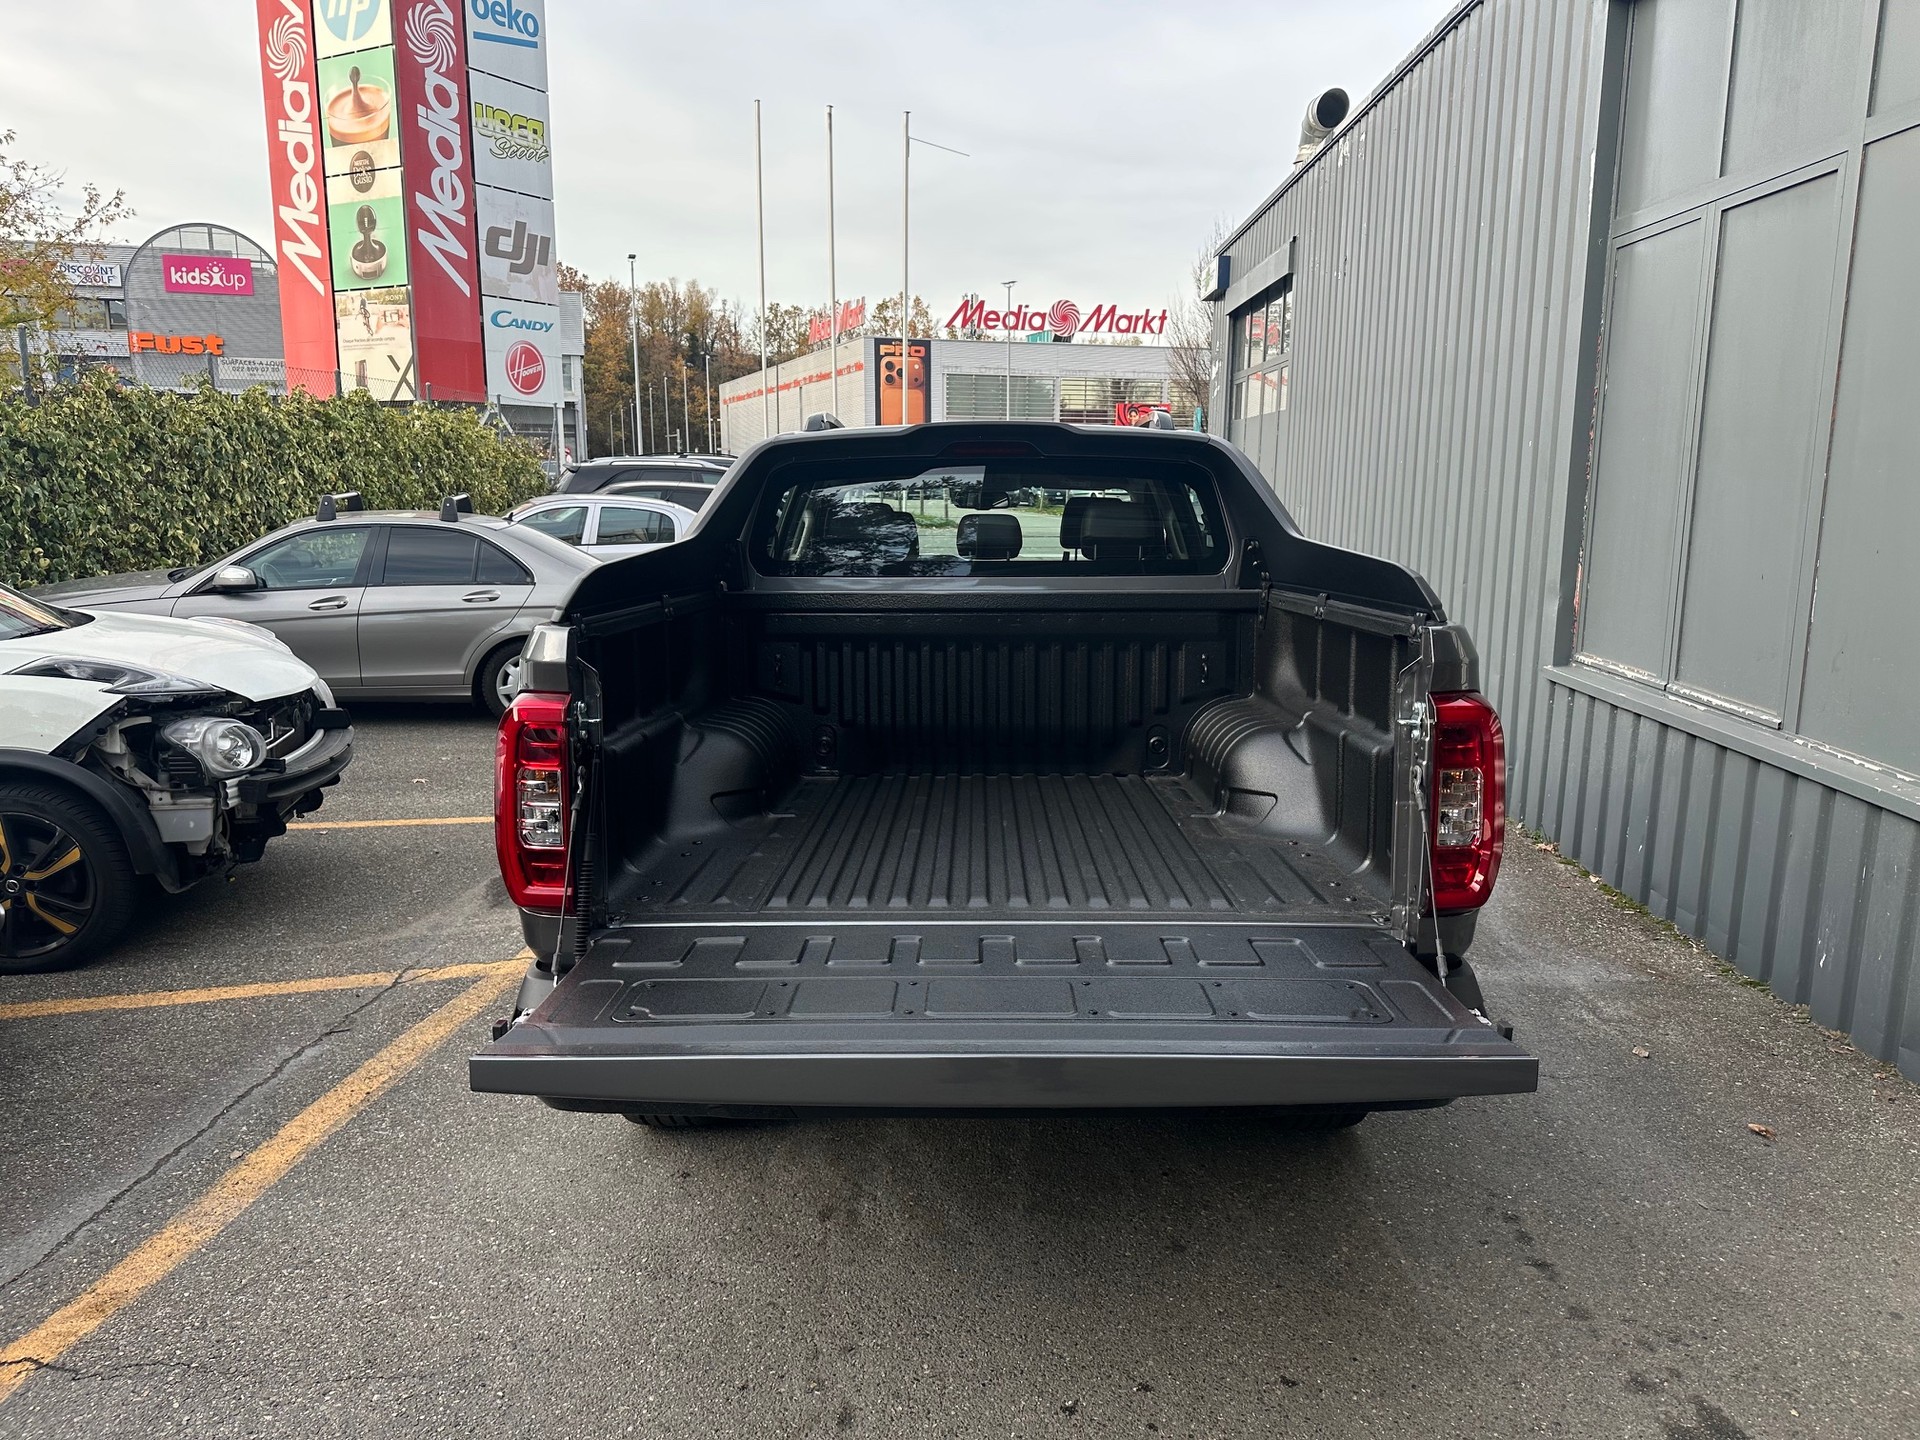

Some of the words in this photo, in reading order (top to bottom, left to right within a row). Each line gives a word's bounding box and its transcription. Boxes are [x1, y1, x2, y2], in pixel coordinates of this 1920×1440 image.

[489, 137, 549, 163] Scoot
[277, 78, 325, 296] Media
[415, 66, 470, 297] Media
[490, 310, 554, 333] CANDY
[944, 299, 1048, 332] Media
[1079, 304, 1168, 334] Markt
